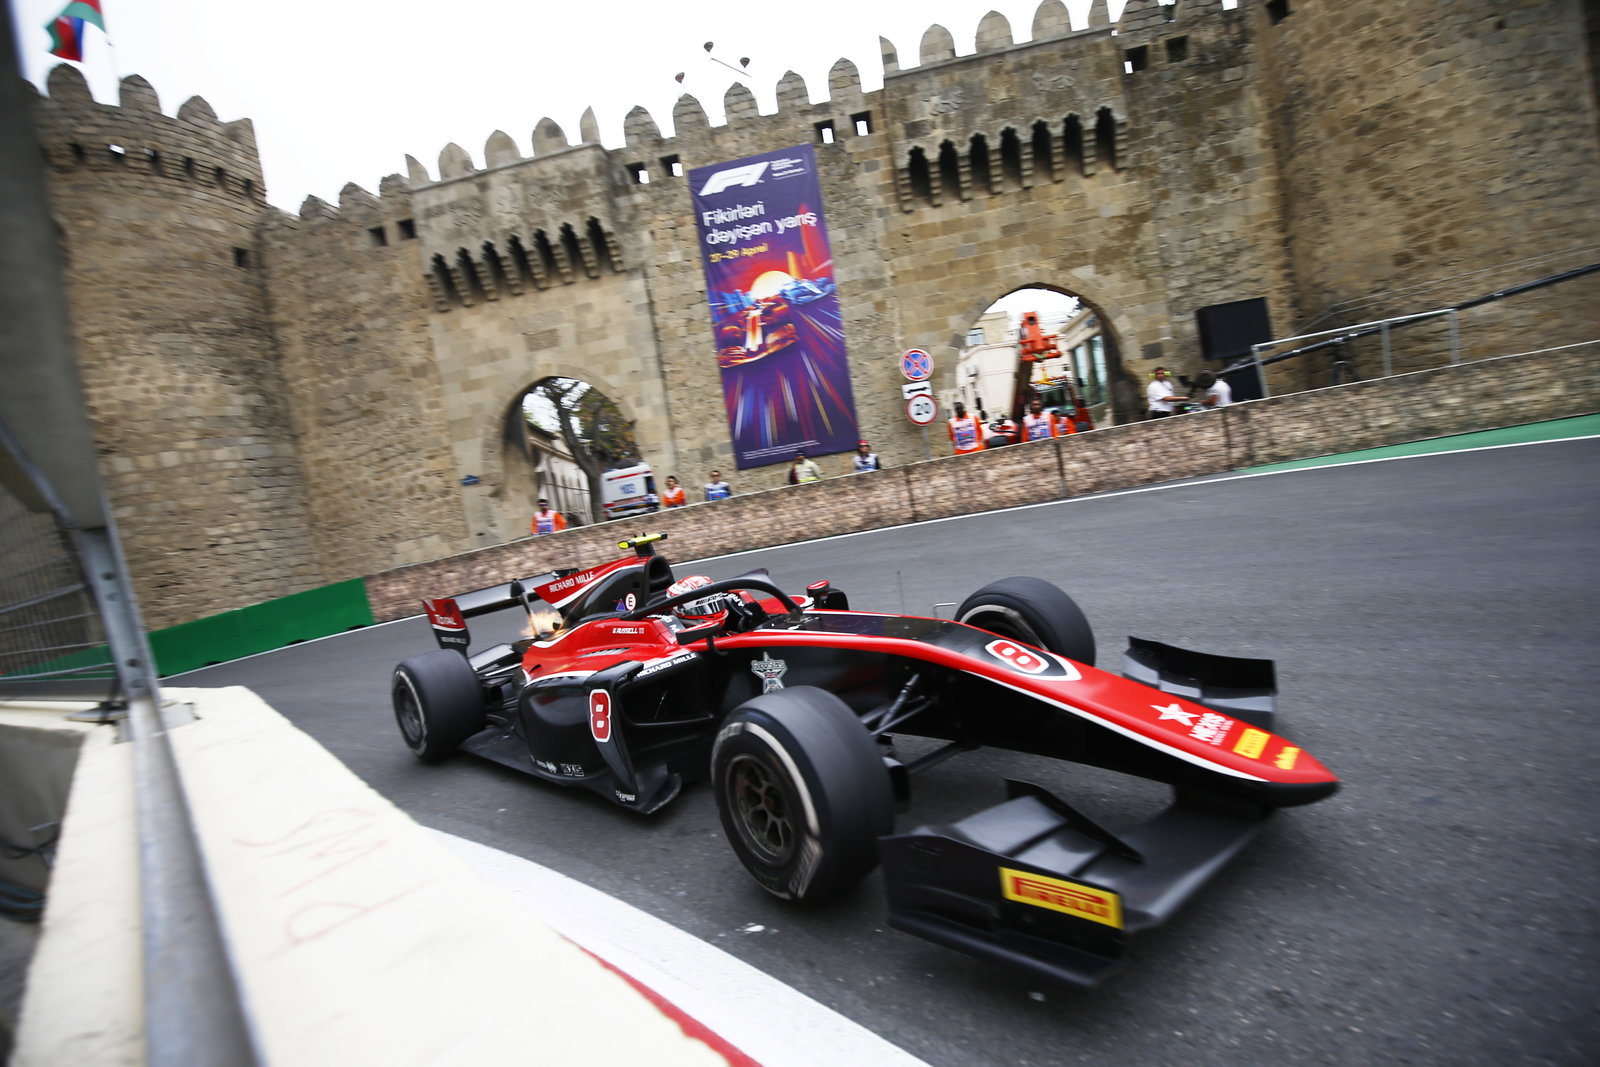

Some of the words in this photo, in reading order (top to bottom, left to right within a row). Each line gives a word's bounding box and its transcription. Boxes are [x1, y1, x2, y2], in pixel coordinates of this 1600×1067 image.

[549, 578, 576, 593] RICHARD
[576, 571, 595, 586] MILLE
[637, 662, 672, 678] RICHARD
[673, 652, 697, 666] MILLE
[986, 640, 1048, 674] 8
[590, 689, 611, 743] 8
